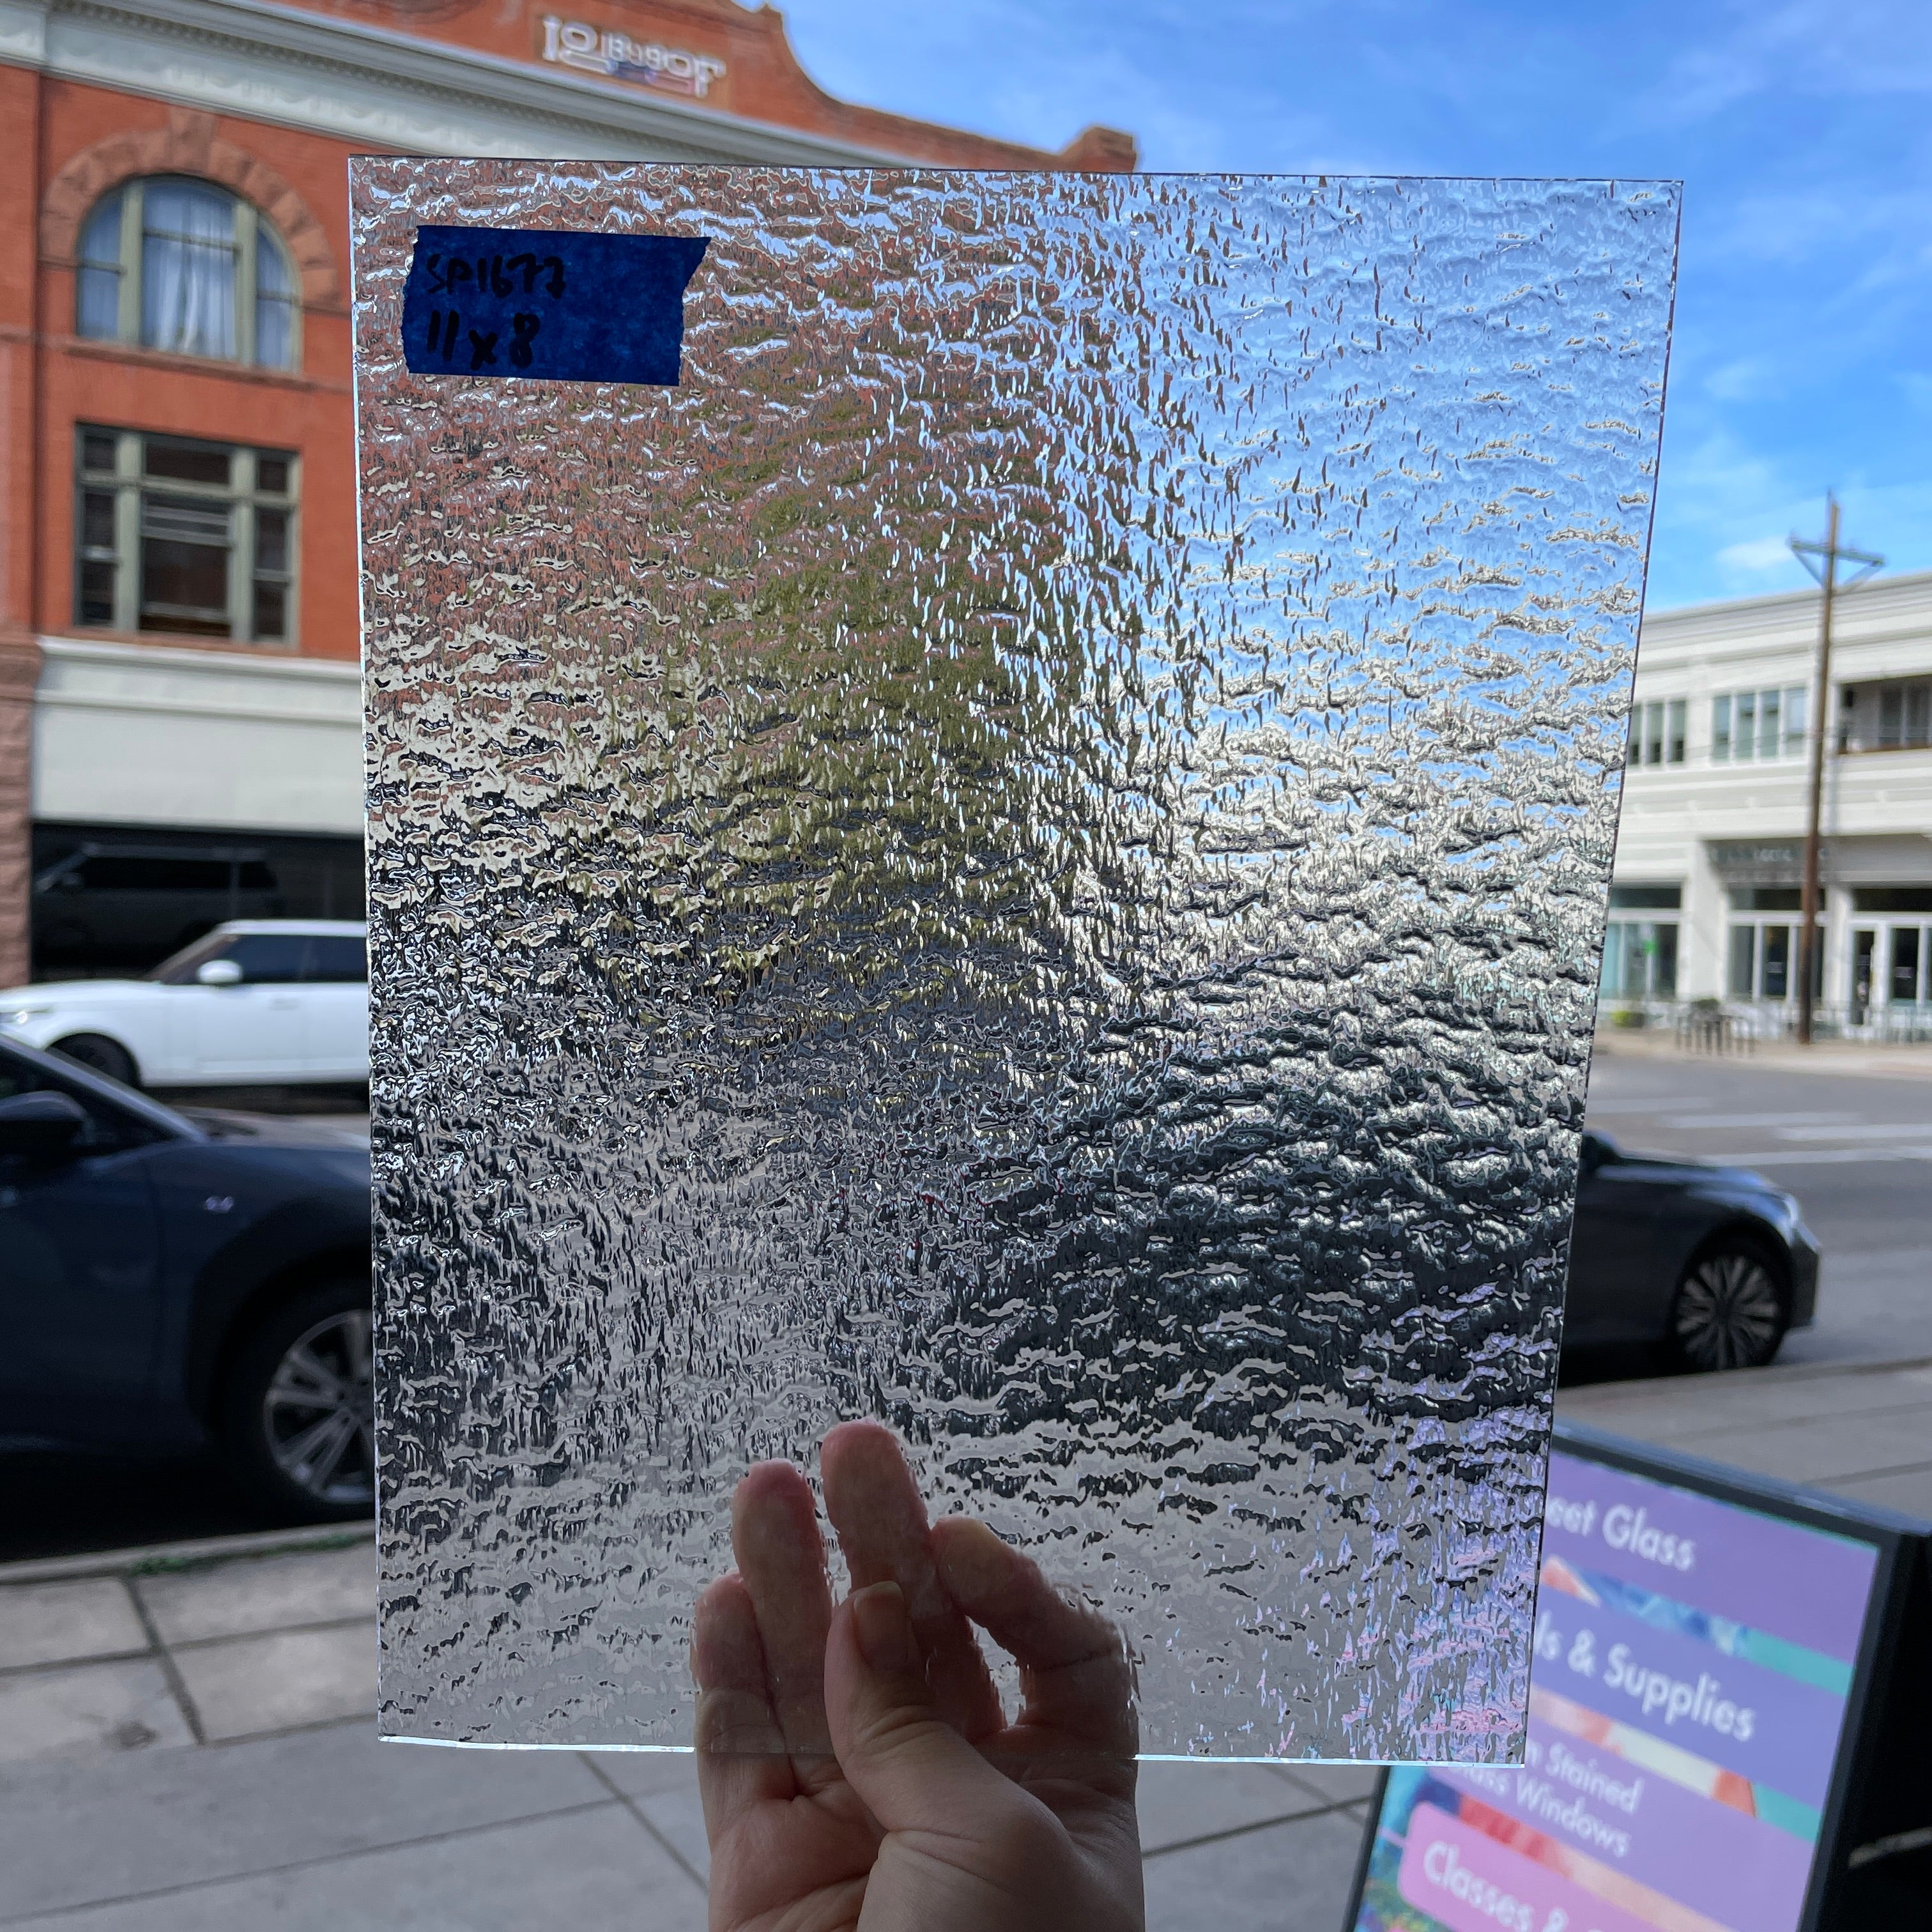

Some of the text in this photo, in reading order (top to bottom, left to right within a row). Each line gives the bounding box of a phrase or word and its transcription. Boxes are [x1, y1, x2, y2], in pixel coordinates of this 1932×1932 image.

[509, 312, 540, 369] 8
[1545, 1498, 1696, 1572] eet Glass
[1568, 1629, 1595, 1678] &
[1603, 1643, 1755, 1742] Supplies
[1516, 1772, 1630, 1858] Windows
[1545, 1742, 1644, 1815] Stained
[1423, 1841, 1533, 1932] Classes
